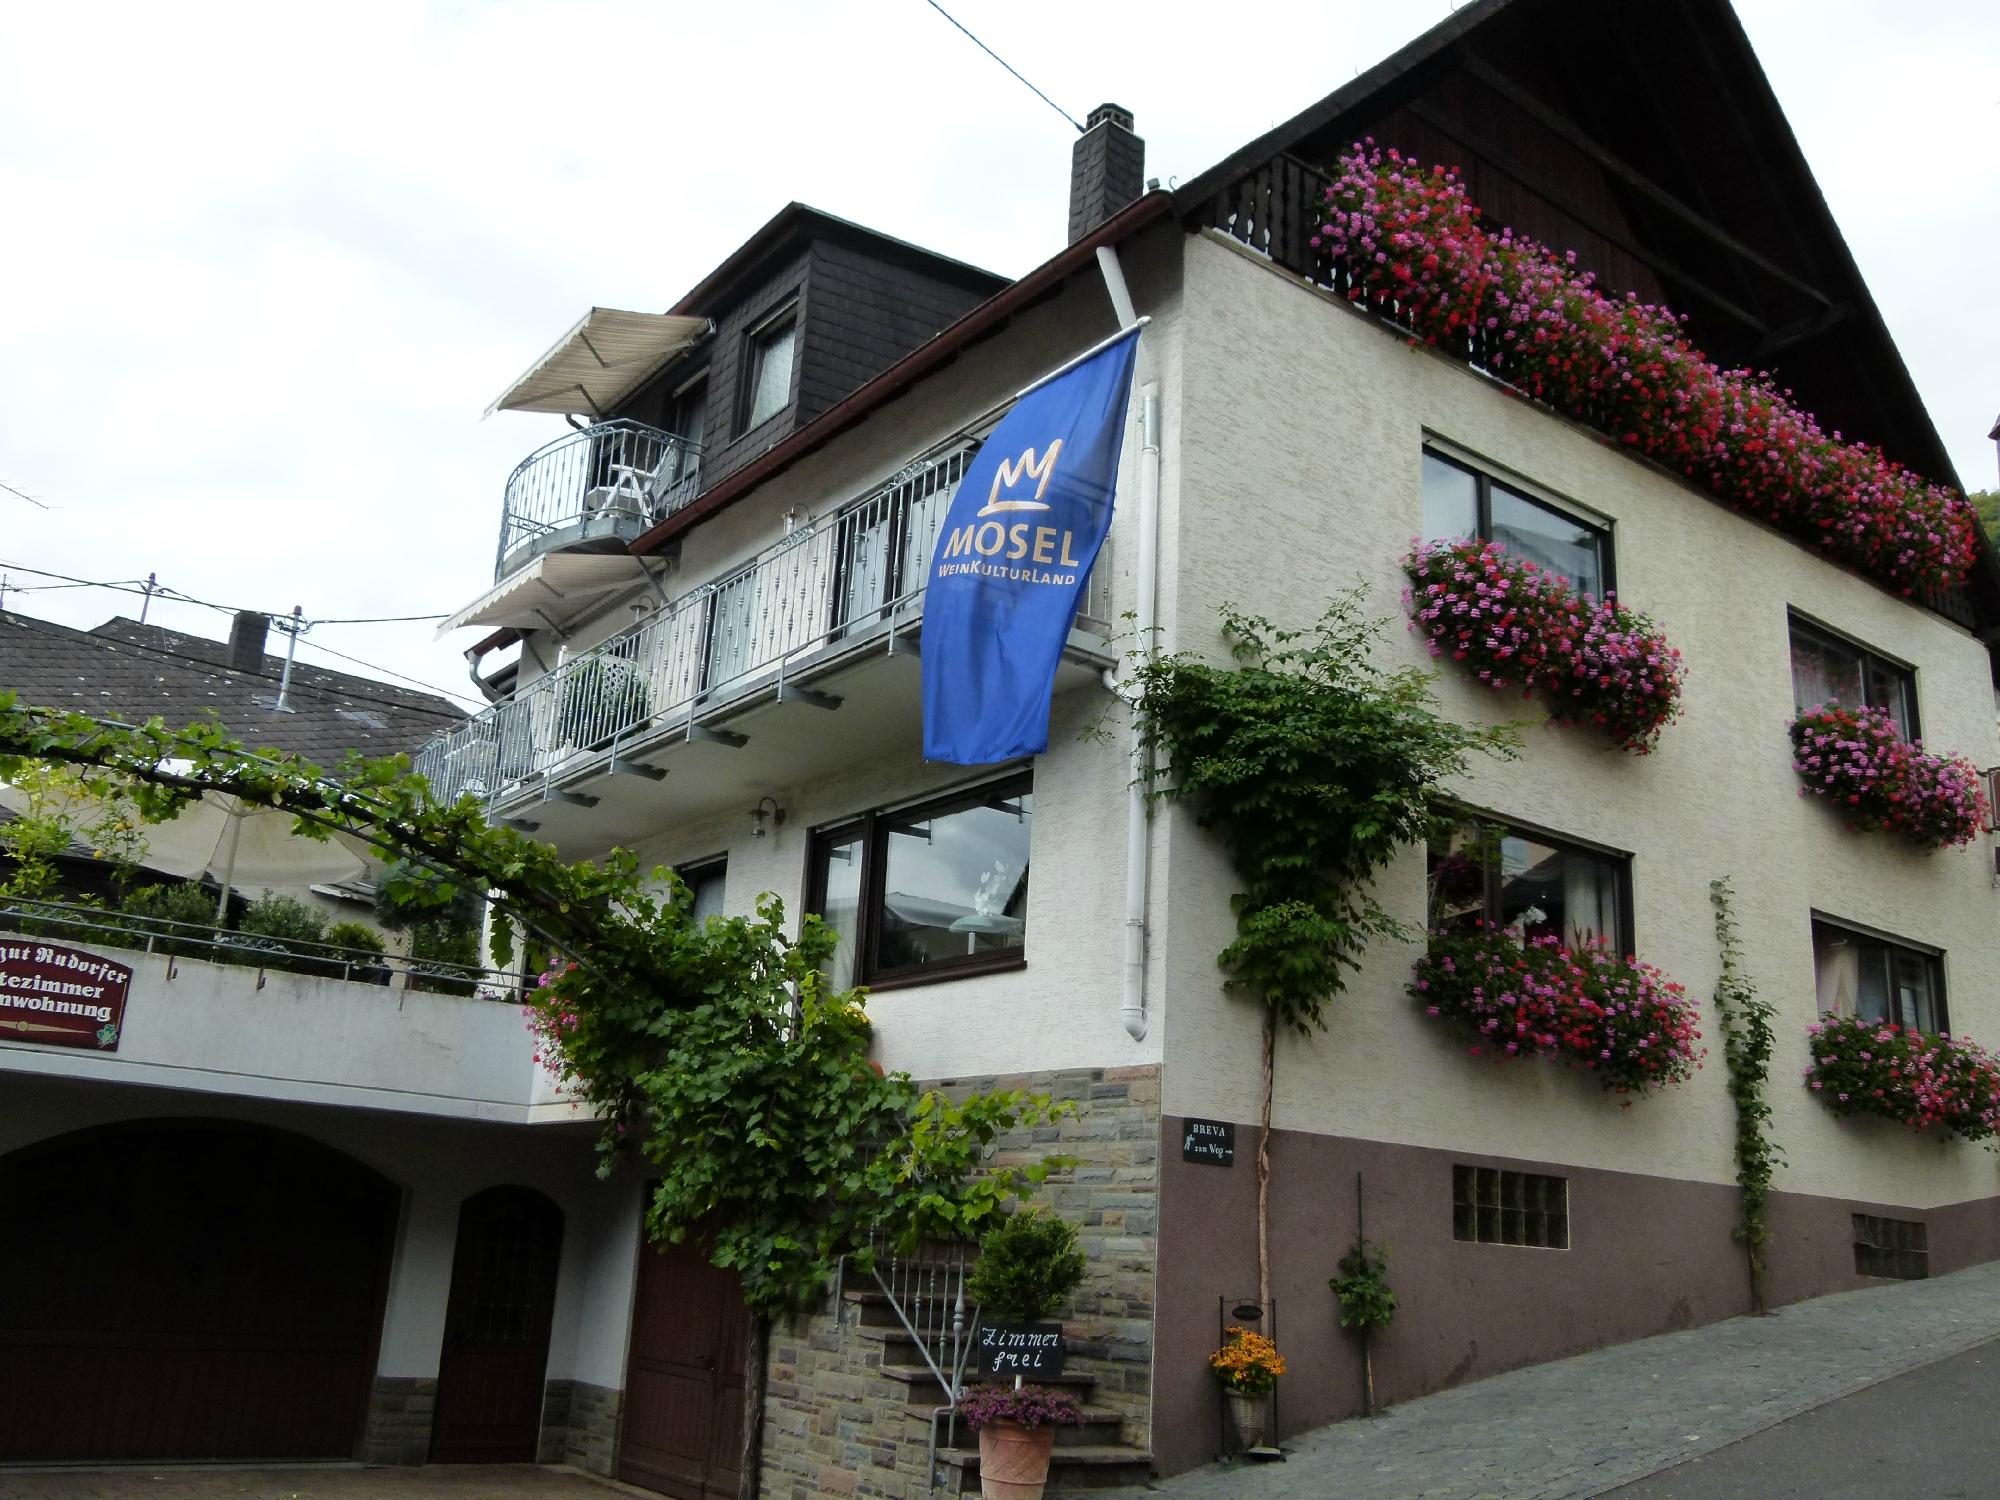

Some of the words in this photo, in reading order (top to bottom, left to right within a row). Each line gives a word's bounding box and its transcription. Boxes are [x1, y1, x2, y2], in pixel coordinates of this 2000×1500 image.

[943, 521, 1079, 568] MOSEL
[0, 971, 105, 999] tezimmer
[1192, 1124, 1225, 1137] BREVA
[982, 1327, 1059, 1347] Zimmer
[992, 1350, 1042, 1372] frei
